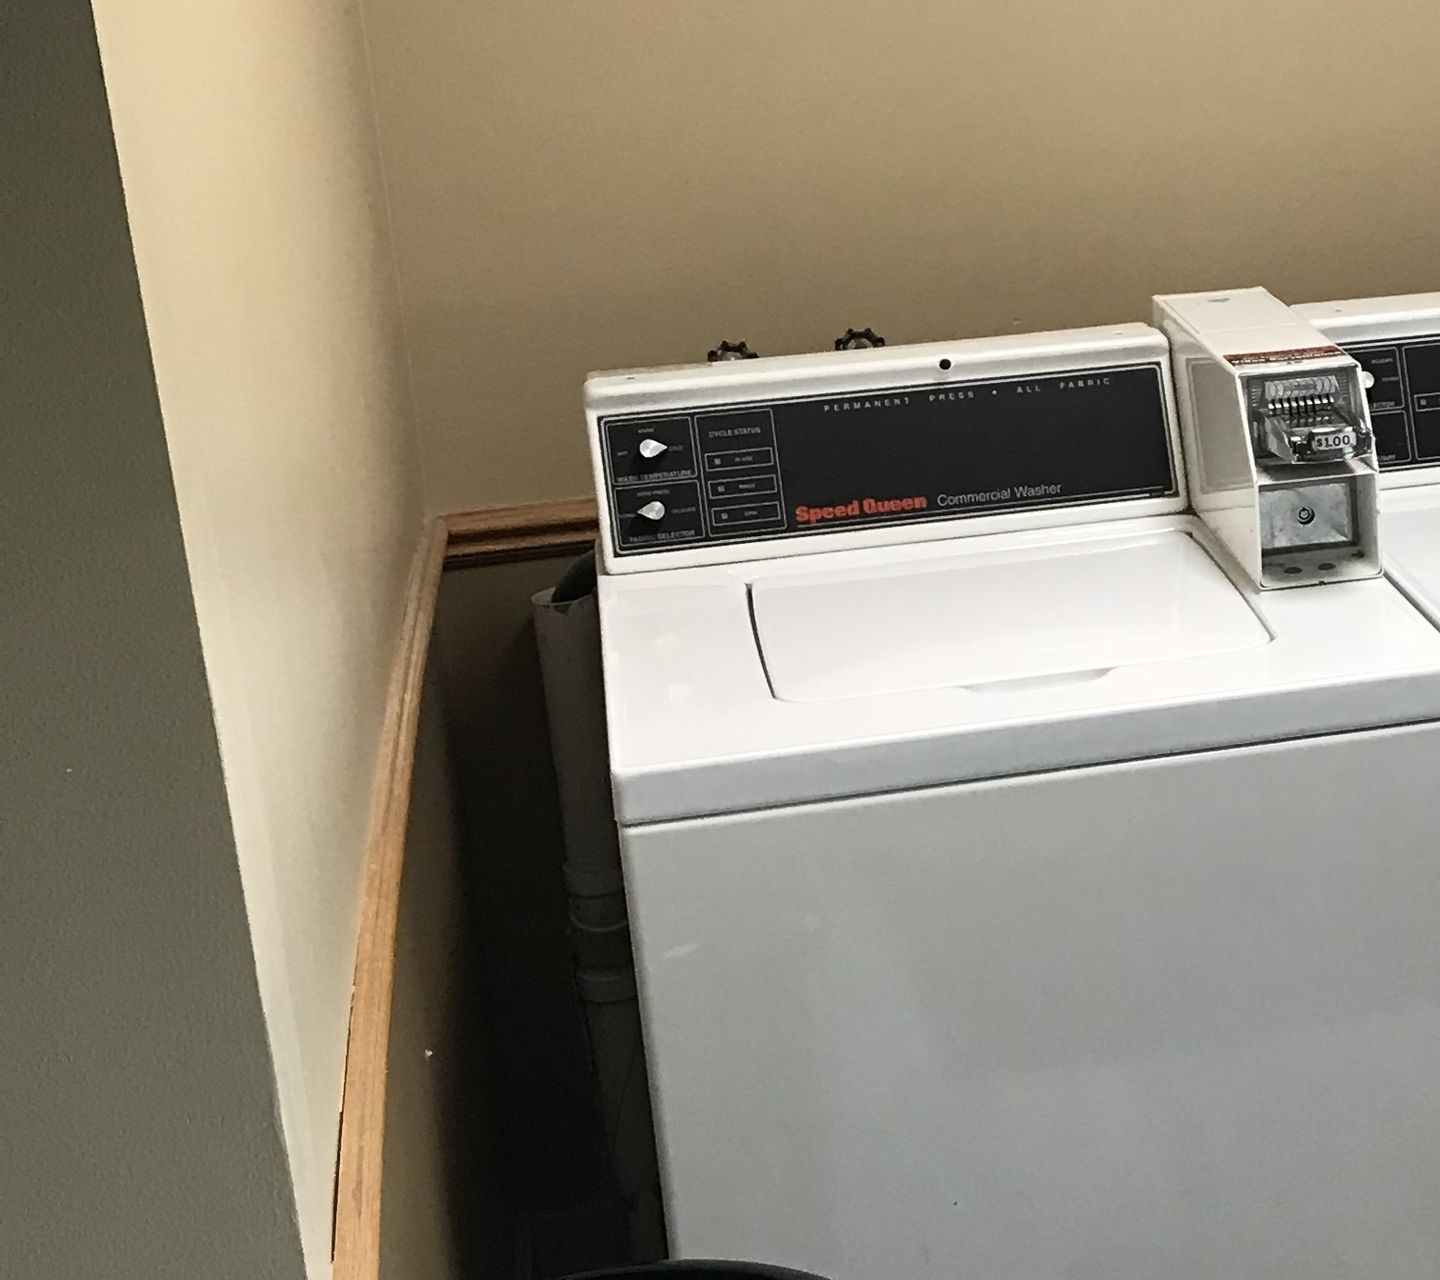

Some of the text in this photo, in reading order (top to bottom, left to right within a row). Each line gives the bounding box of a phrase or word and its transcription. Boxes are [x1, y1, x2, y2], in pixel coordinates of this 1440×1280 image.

[823, 378, 1110, 412] PERMANENT PRESS ALL FABRIC
[795, 483, 1062, 524] Speed Queen Commercial Washer
